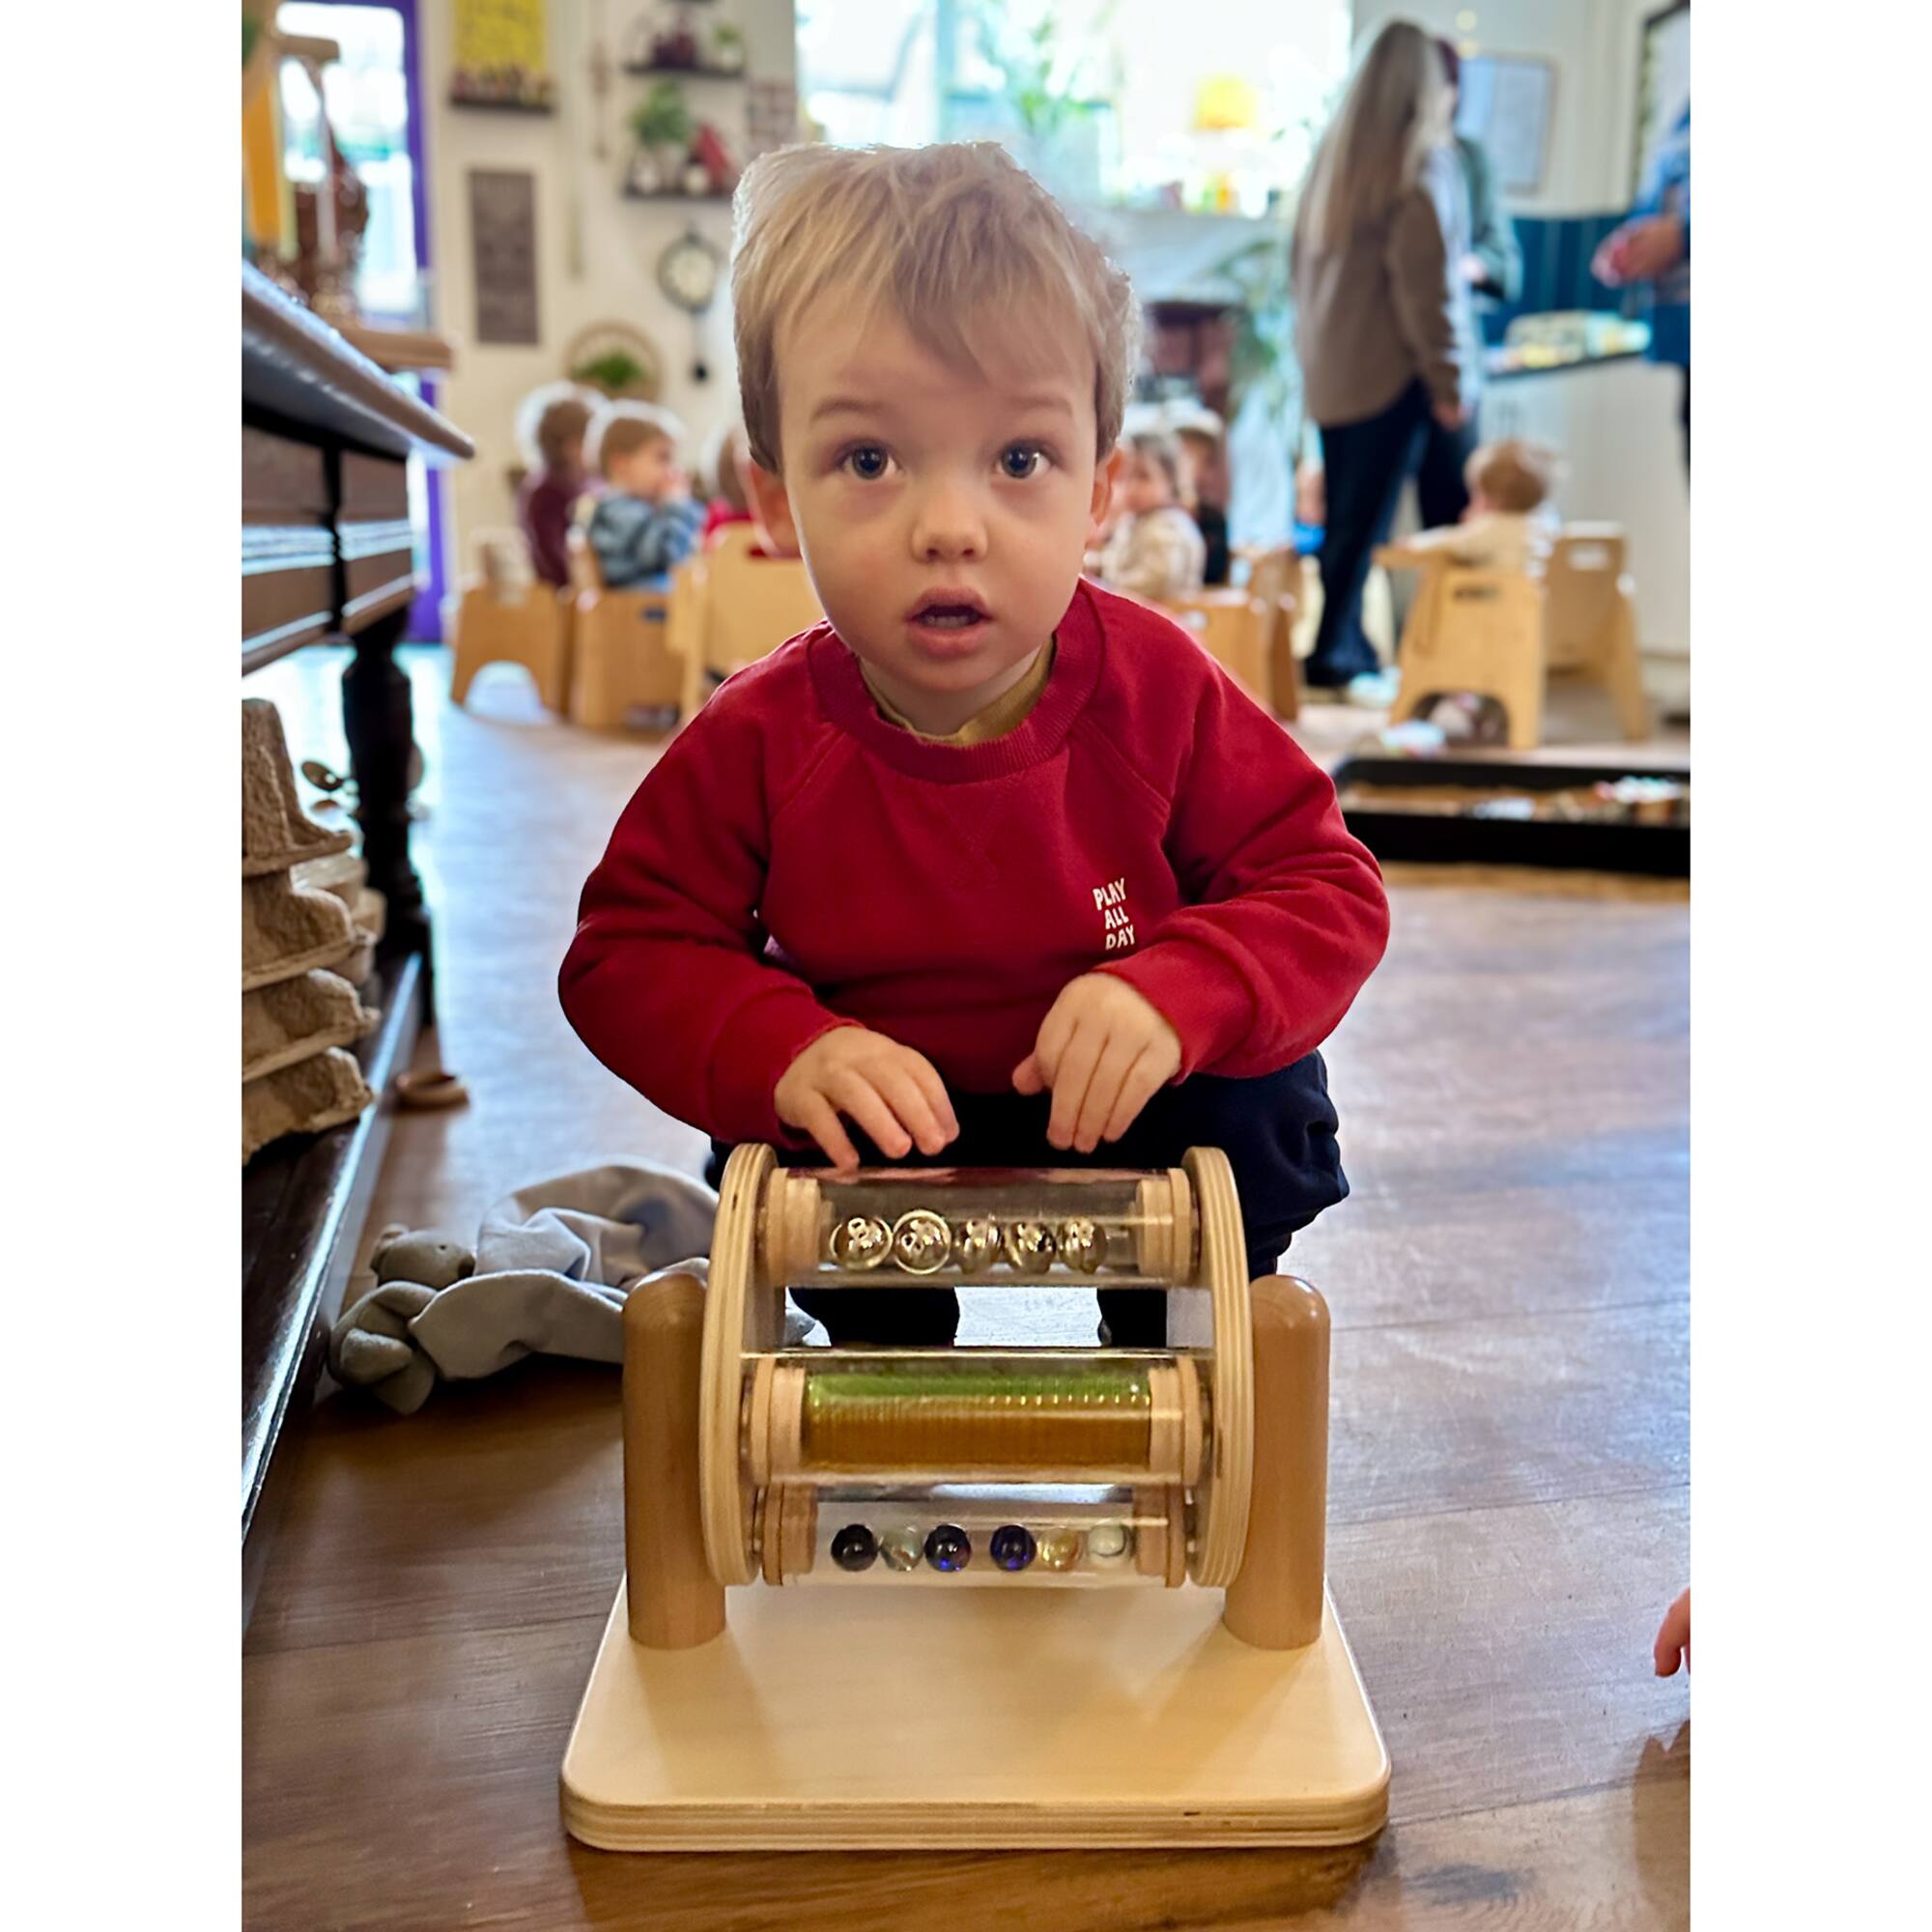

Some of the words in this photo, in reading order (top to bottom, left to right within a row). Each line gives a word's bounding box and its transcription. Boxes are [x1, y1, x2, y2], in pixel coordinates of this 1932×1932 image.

[1093, 877, 1126, 911] PLAY
[1104, 906, 1129, 929] ALL
[1105, 924, 1135, 951] DAY
